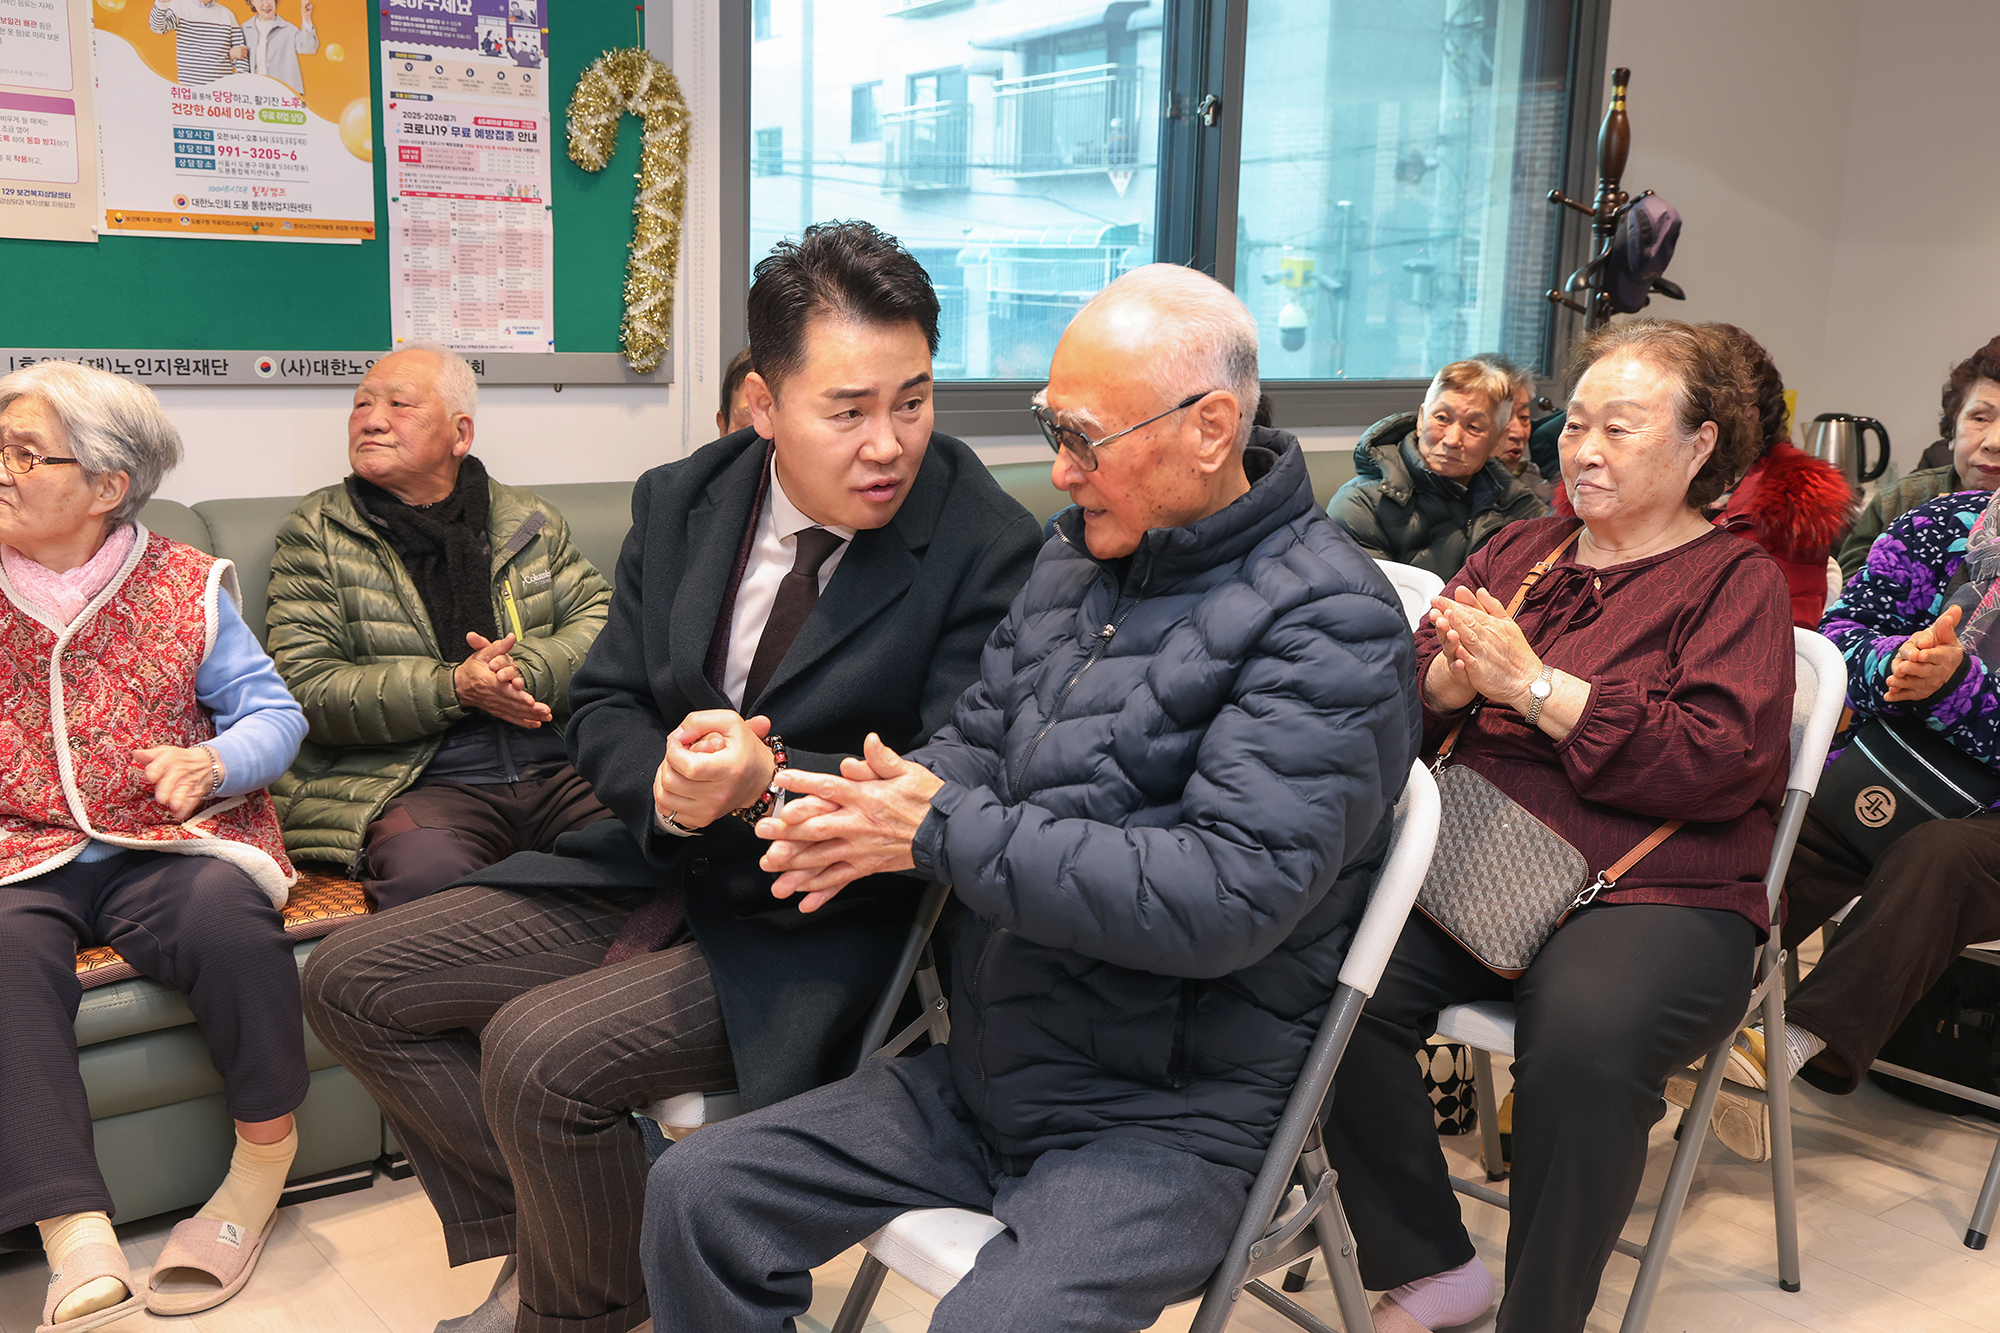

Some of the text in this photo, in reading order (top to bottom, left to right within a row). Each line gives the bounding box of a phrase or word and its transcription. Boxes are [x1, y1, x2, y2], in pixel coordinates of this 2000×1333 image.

[0, 17, 21, 26] 보일러
[23, 19, 37, 28] 배관
[170, 86, 198, 101] 취업을
[199, 93, 212, 101] 통해
[212, 90, 253, 105] 당당하고,
[254, 95, 279, 107] 활기찬
[172, 102, 255, 121] 건강한 60세 이상
[402, 111, 457, 122] 2025-2026절기
[1, 125, 14, 133] 조금
[176, 129, 211, 140] 상담시간
[217, 132, 229, 141] 오전
[404, 122, 537, 143] 코로나19 무료 예방접종 안내
[42, 138, 69, 147] 방지하기
[177, 144, 298, 161] 상담전화 991-3205~6
[178, 158, 213, 169] 상담장소
[17, 189, 71, 199] 보건복지상담센터
[191, 198, 312, 213] 대한노인회 도봉 통합취업지원센터
[524, 570, 551, 584] Columb
